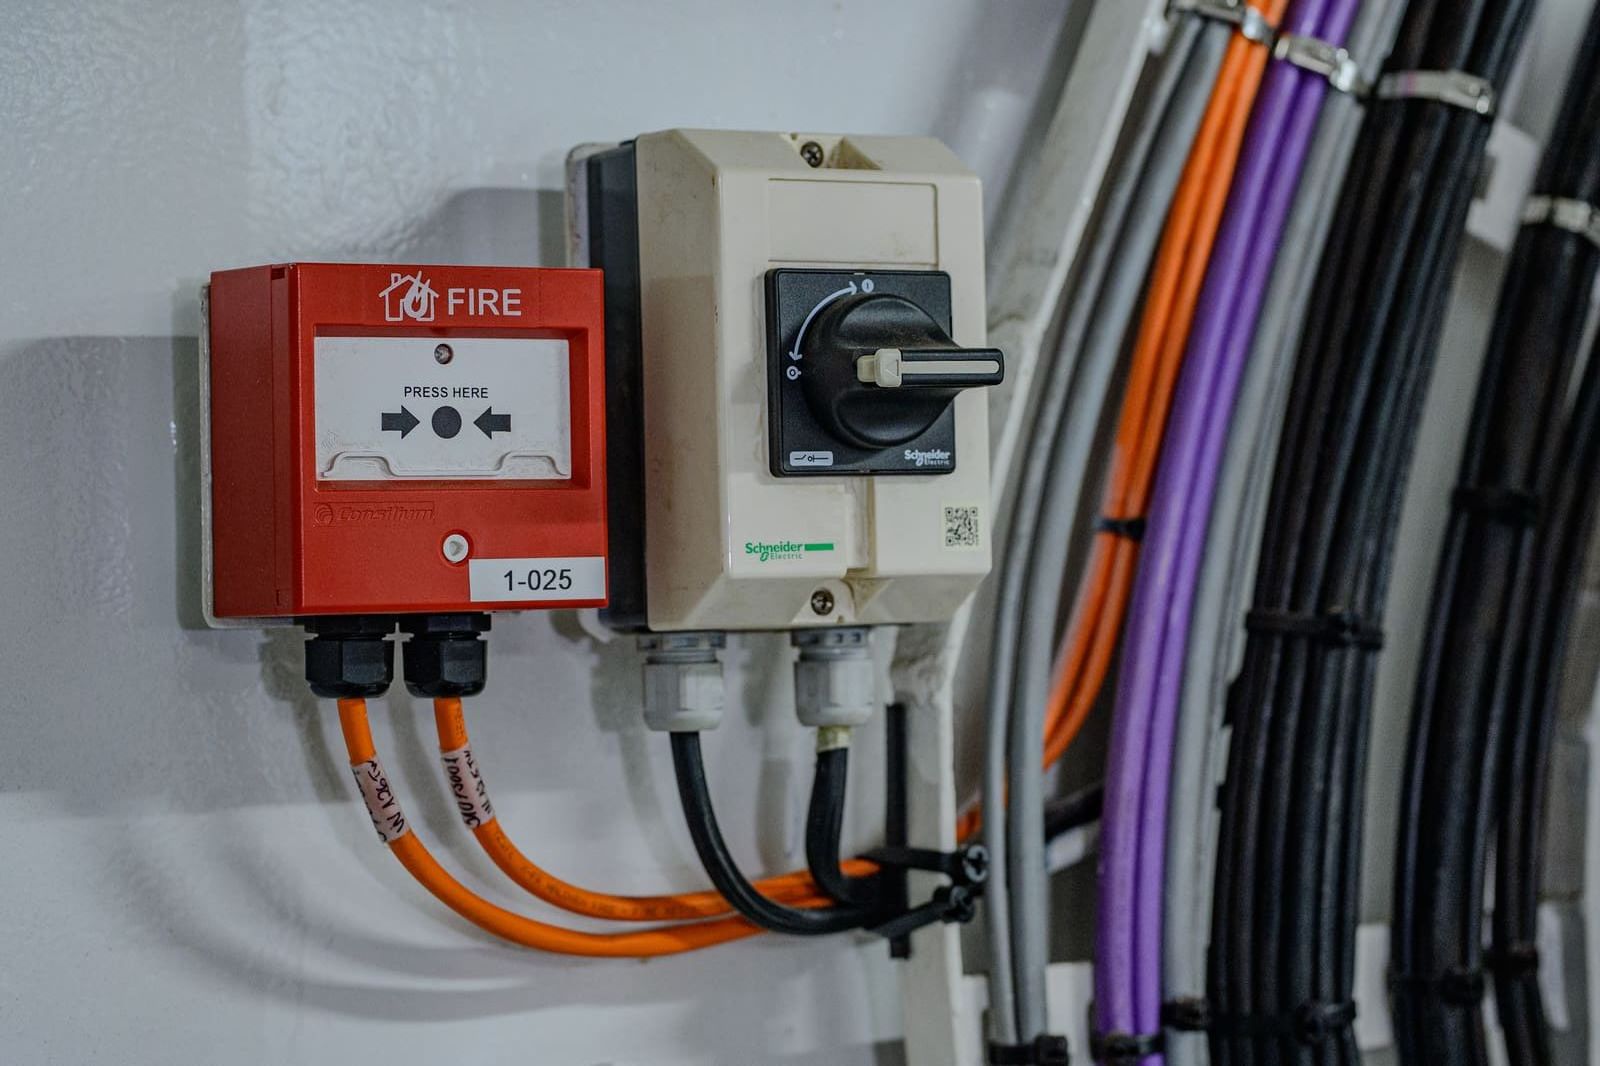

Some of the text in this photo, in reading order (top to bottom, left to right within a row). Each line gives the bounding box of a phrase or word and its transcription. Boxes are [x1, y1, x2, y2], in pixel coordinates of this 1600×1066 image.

[447, 288, 522, 316] FIRE
[404, 386, 489, 399] PRESS HERE
[904, 449, 951, 463] Schneider
[340, 505, 434, 521] Consilium
[745, 541, 803, 558] Schneider
[503, 568, 573, 592] 1-025
